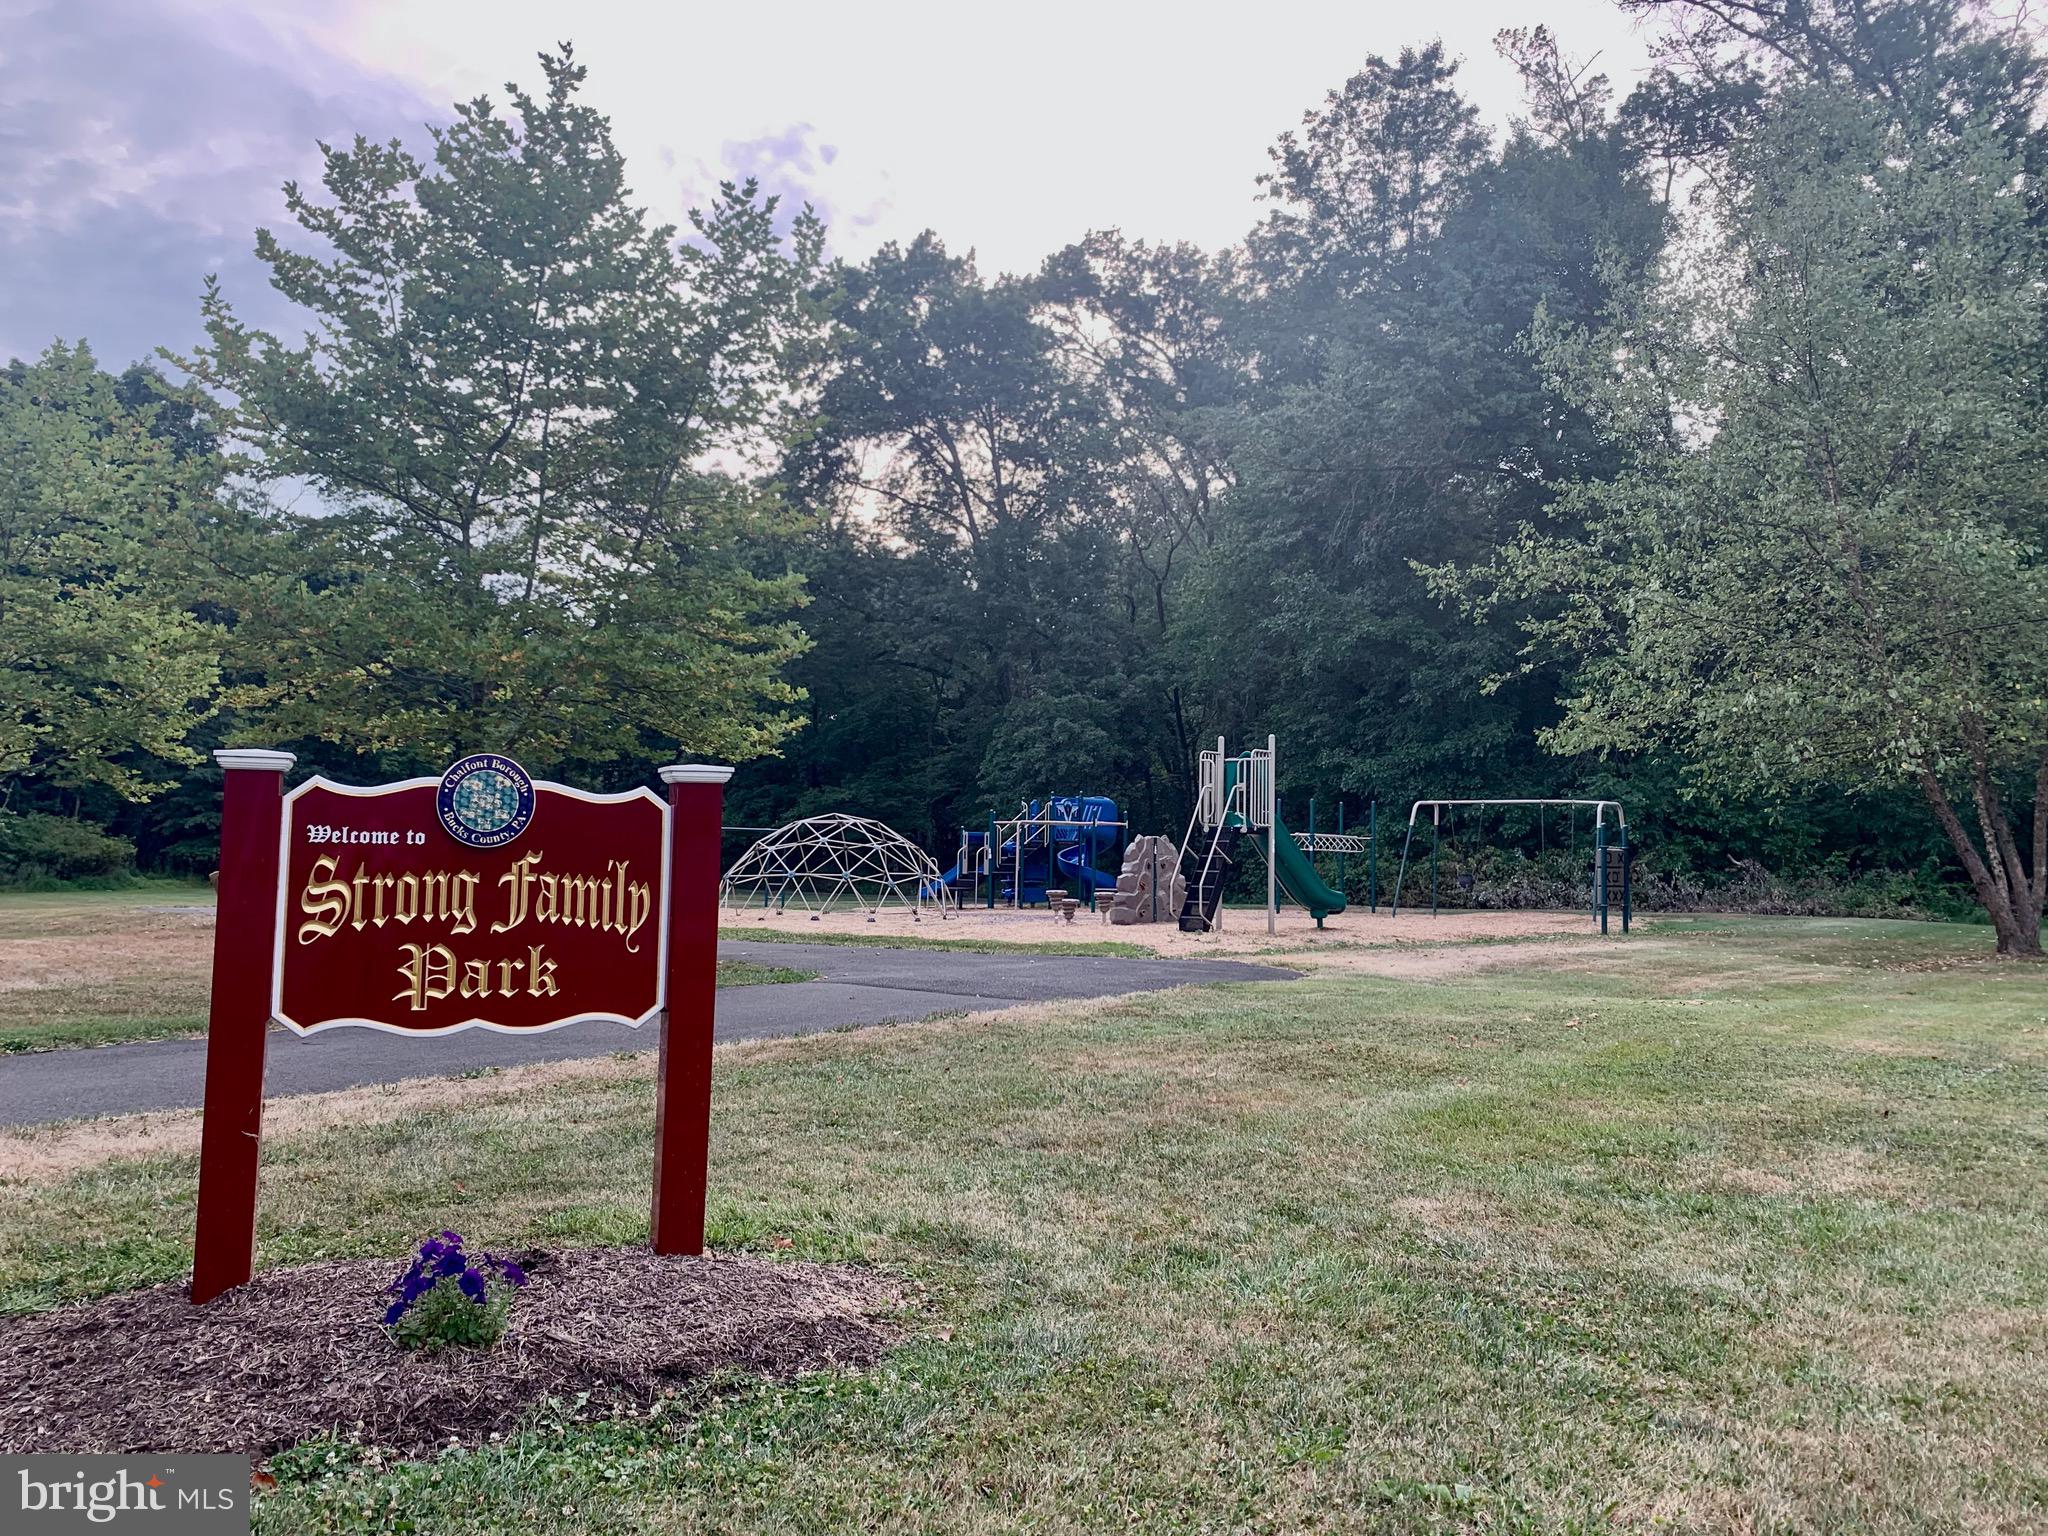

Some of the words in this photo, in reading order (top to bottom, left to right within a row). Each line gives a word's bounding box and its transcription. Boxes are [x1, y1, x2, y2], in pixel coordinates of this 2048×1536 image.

[445, 759, 488, 788] Chalfont
[491, 759, 529, 793] Borough
[306, 825, 400, 845] Welcome
[406, 829, 426, 845] to
[443, 811, 469, 839] Bucks
[471, 831, 515, 844] County,
[511, 816, 527, 829] PA
[298, 853, 480, 945] Strong
[490, 850, 651, 953] Family
[392, 942, 560, 1011] Park
